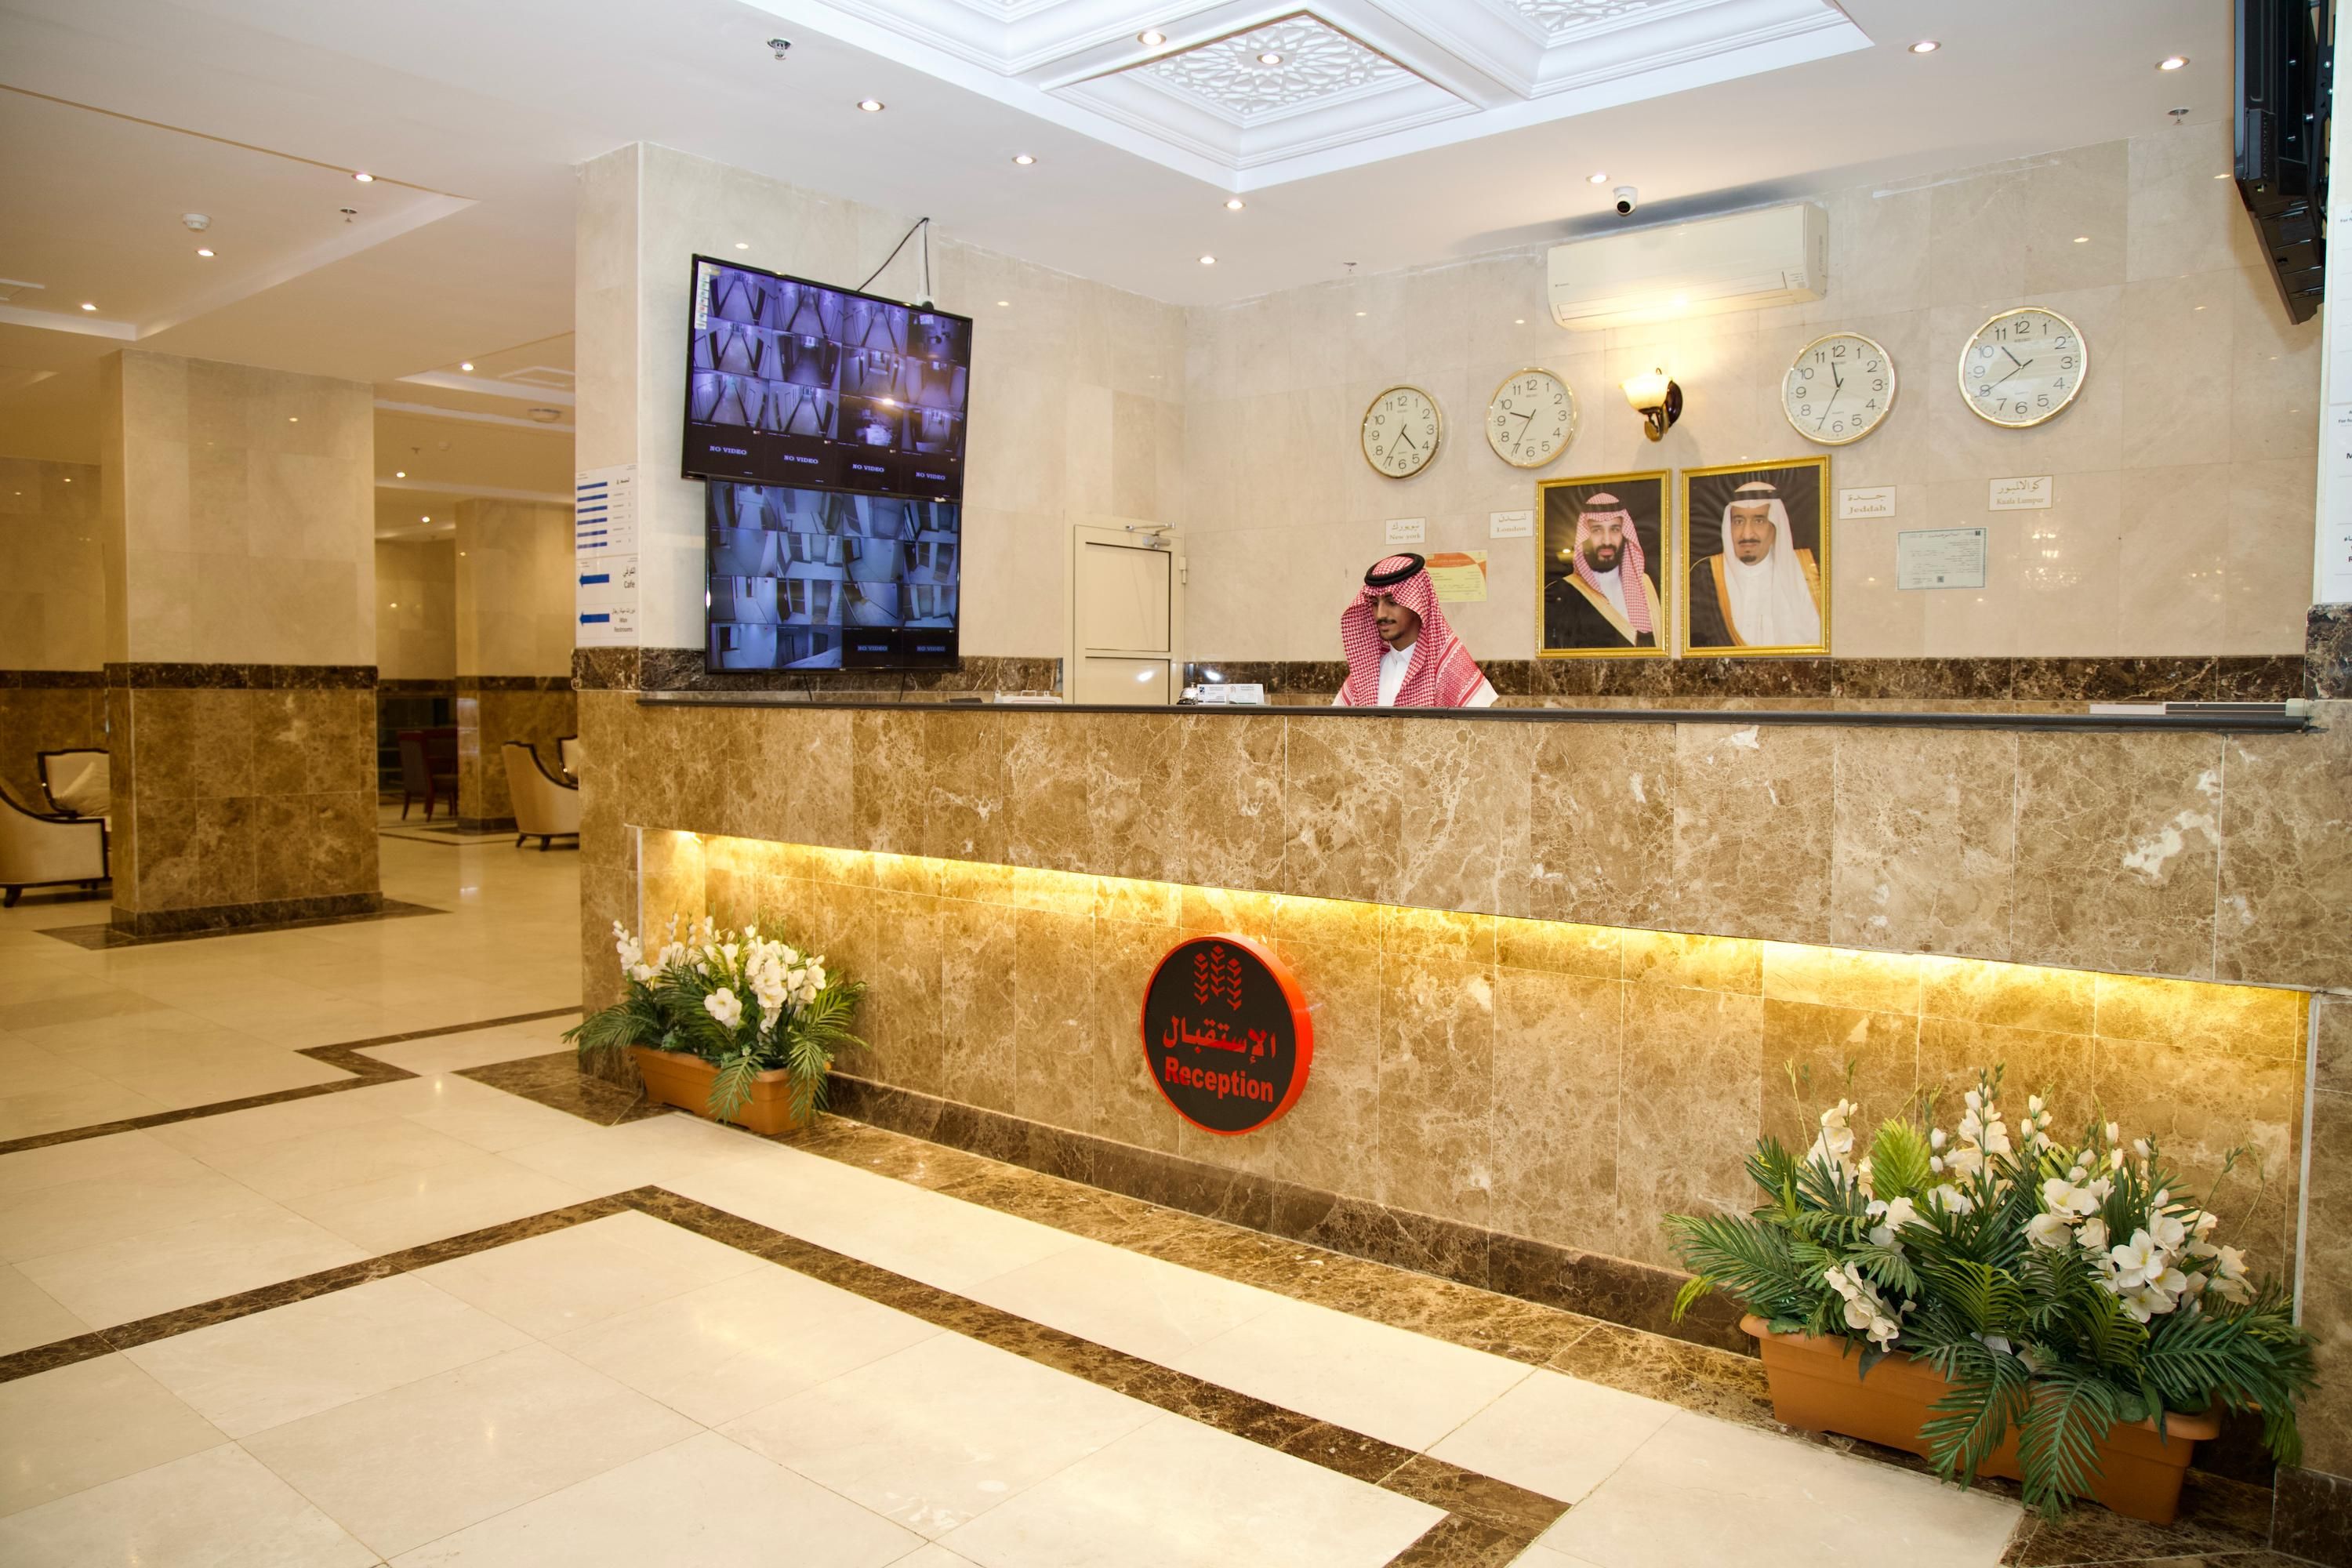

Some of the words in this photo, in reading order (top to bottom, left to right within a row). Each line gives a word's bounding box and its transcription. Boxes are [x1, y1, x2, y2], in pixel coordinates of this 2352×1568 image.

[2014, 321, 2030, 334] 12
[1994, 328, 2006, 341] 11
[2055, 336, 2067, 350] 2
[1832, 345, 1846, 358] 12
[1978, 346, 1994, 358] 10
[1815, 352, 1824, 364] 11
[2061, 357, 2073, 369] 3
[1867, 361, 1877, 372] 2
[1973, 365, 1985, 378] 9
[1800, 368, 1814, 379] 10
[1526, 379, 1537, 390] 12
[1872, 379, 1883, 391] 3
[2053, 377, 2065, 390] 4
[1513, 385, 1521, 395] 11
[1796, 387, 1806, 398] 9
[1980, 384, 1991, 397] 8
[1397, 396, 1408, 406] 12
[1501, 398, 1512, 410] 10
[1554, 394, 1563, 405] 2
[1865, 398, 1876, 410] 4
[1996, 398, 2007, 411] 7
[2037, 394, 2049, 407] 5
[1385, 401, 1393, 412] 11
[1801, 404, 1811, 416] 8
[2015, 401, 2027, 414] 6
[1422, 408, 1430, 419] 2
[1558, 410, 1566, 421] 3
[1374, 415, 1385, 425] 10
[1497, 415, 1505, 426] 9
[1816, 417, 1825, 430] 7
[1851, 414, 1862, 426] 5
[1426, 424, 1434, 435] 3
[1552, 427, 1562, 437] 4
[1832, 420, 1843, 433] 6
[1372, 430, 1380, 441] 9
[1501, 431, 1509, 442] 8
[1375, 445, 1383, 456] 8
[1422, 441, 1429, 450] 4
[1513, 443, 1521, 455] 7
[1541, 441, 1550, 452] 5
[723, 447, 747, 456] VIDEO
[1526, 446, 1535, 457] 6
[797, 456, 818, 465] VIDEO
[1387, 456, 1394, 466] 7
[1399, 459, 1406, 469] 6
[1412, 454, 1420, 464] 5
[2017, 496, 2045, 506] Lumpur
[1847, 504, 1886, 514] Jeddah
[1497, 524, 1526, 532] London
[1165, 1056, 1273, 1103] Reception
